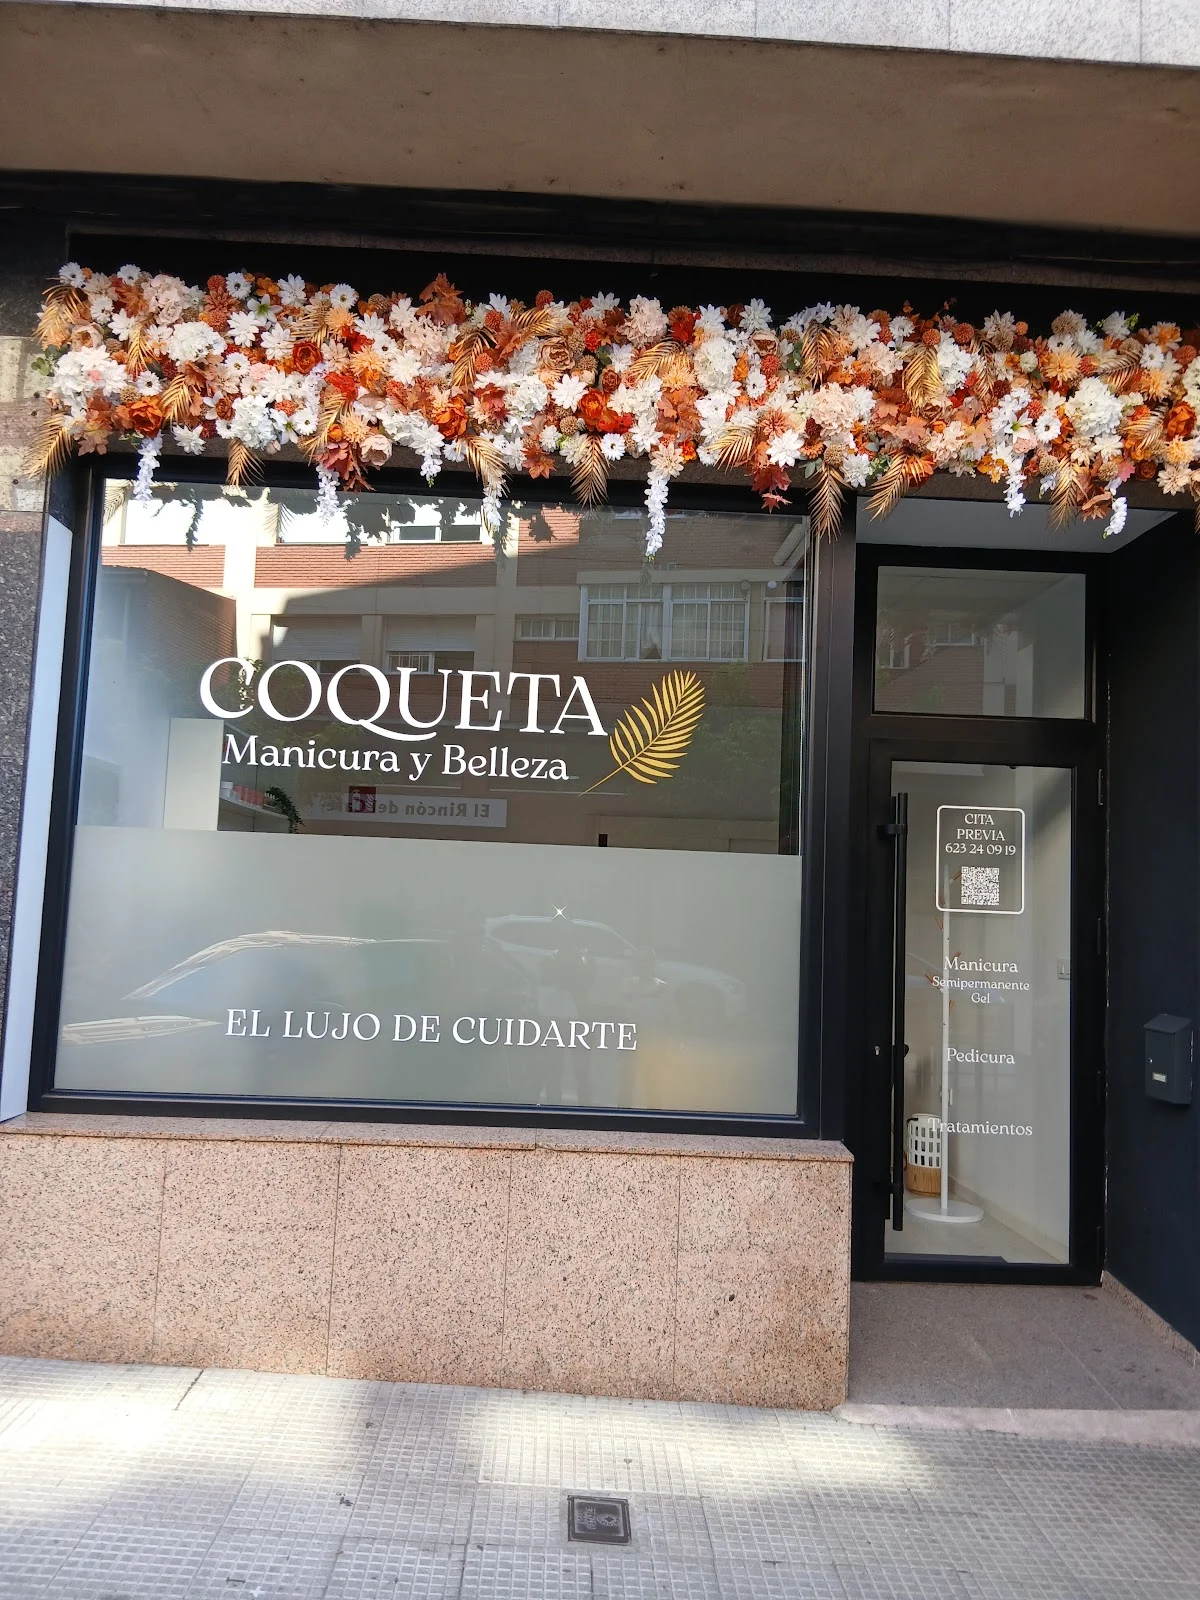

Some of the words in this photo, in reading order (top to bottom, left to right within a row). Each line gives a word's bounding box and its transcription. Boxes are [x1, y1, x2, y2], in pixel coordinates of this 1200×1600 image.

[200, 657, 608, 741] COQUETA
[222, 733, 400, 772] Manicura
[408, 752, 432, 781] y
[441, 744, 570, 780] Belleza
[964, 813, 995, 825] CITA
[956, 828, 1005, 841] PREVIA
[945, 842, 967, 853] 623
[969, 844, 984, 854] 24
[986, 844, 1003, 855] 09
[1004, 845, 1016, 855] 19
[943, 956, 1018, 973] Manicura
[932, 975, 1030, 991] Semipermanente
[971, 992, 990, 1003] Gel
[225, 1009, 270, 1037] EL
[282, 1010, 381, 1041] LUJO
[392, 1014, 440, 1043] DE
[452, 1015, 638, 1051] CUIDARTE
[946, 1047, 1016, 1065] Pedicura
[927, 1117, 1033, 1136] Tratamientos
